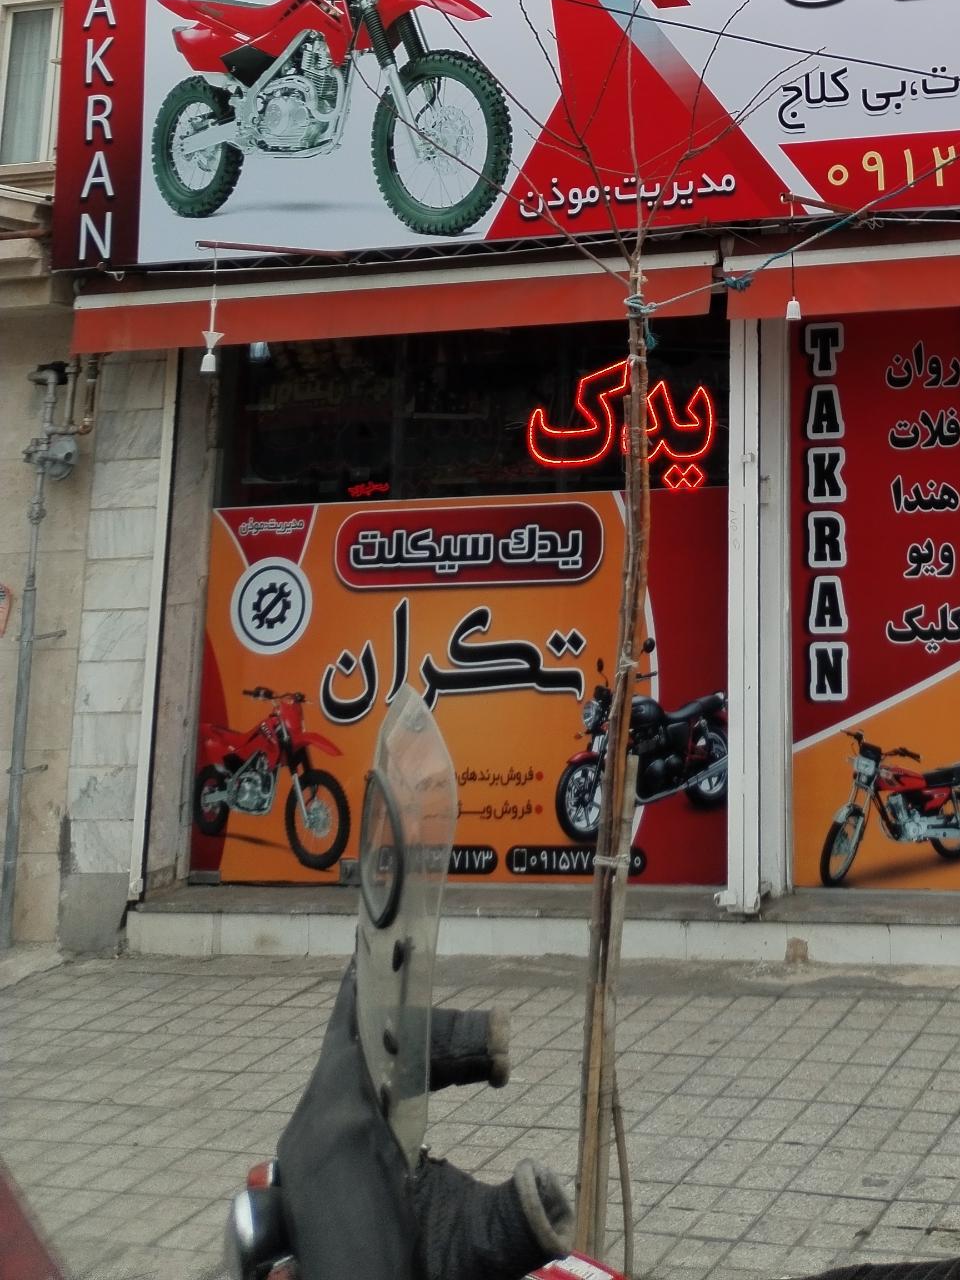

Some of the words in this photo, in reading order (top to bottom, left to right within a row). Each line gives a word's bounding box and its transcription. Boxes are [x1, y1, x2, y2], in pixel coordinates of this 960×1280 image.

[778, 67, 849, 129] کلاج
[886, 340, 960, 389] روان
[527, 358, 714, 490] یدک
[805, 322, 849, 701] TAKRAN
[891, 475, 960, 515] هندا
[351, 526, 493, 575] سیکلت
[904, 536, 956, 579] ویو
[319, 597, 585, 723] تکران
[501, 766, 534, 786] فروش
[494, 800, 533, 820] فروش
[530, 850, 642, 871] ۰۹۱۵۷۷۰
